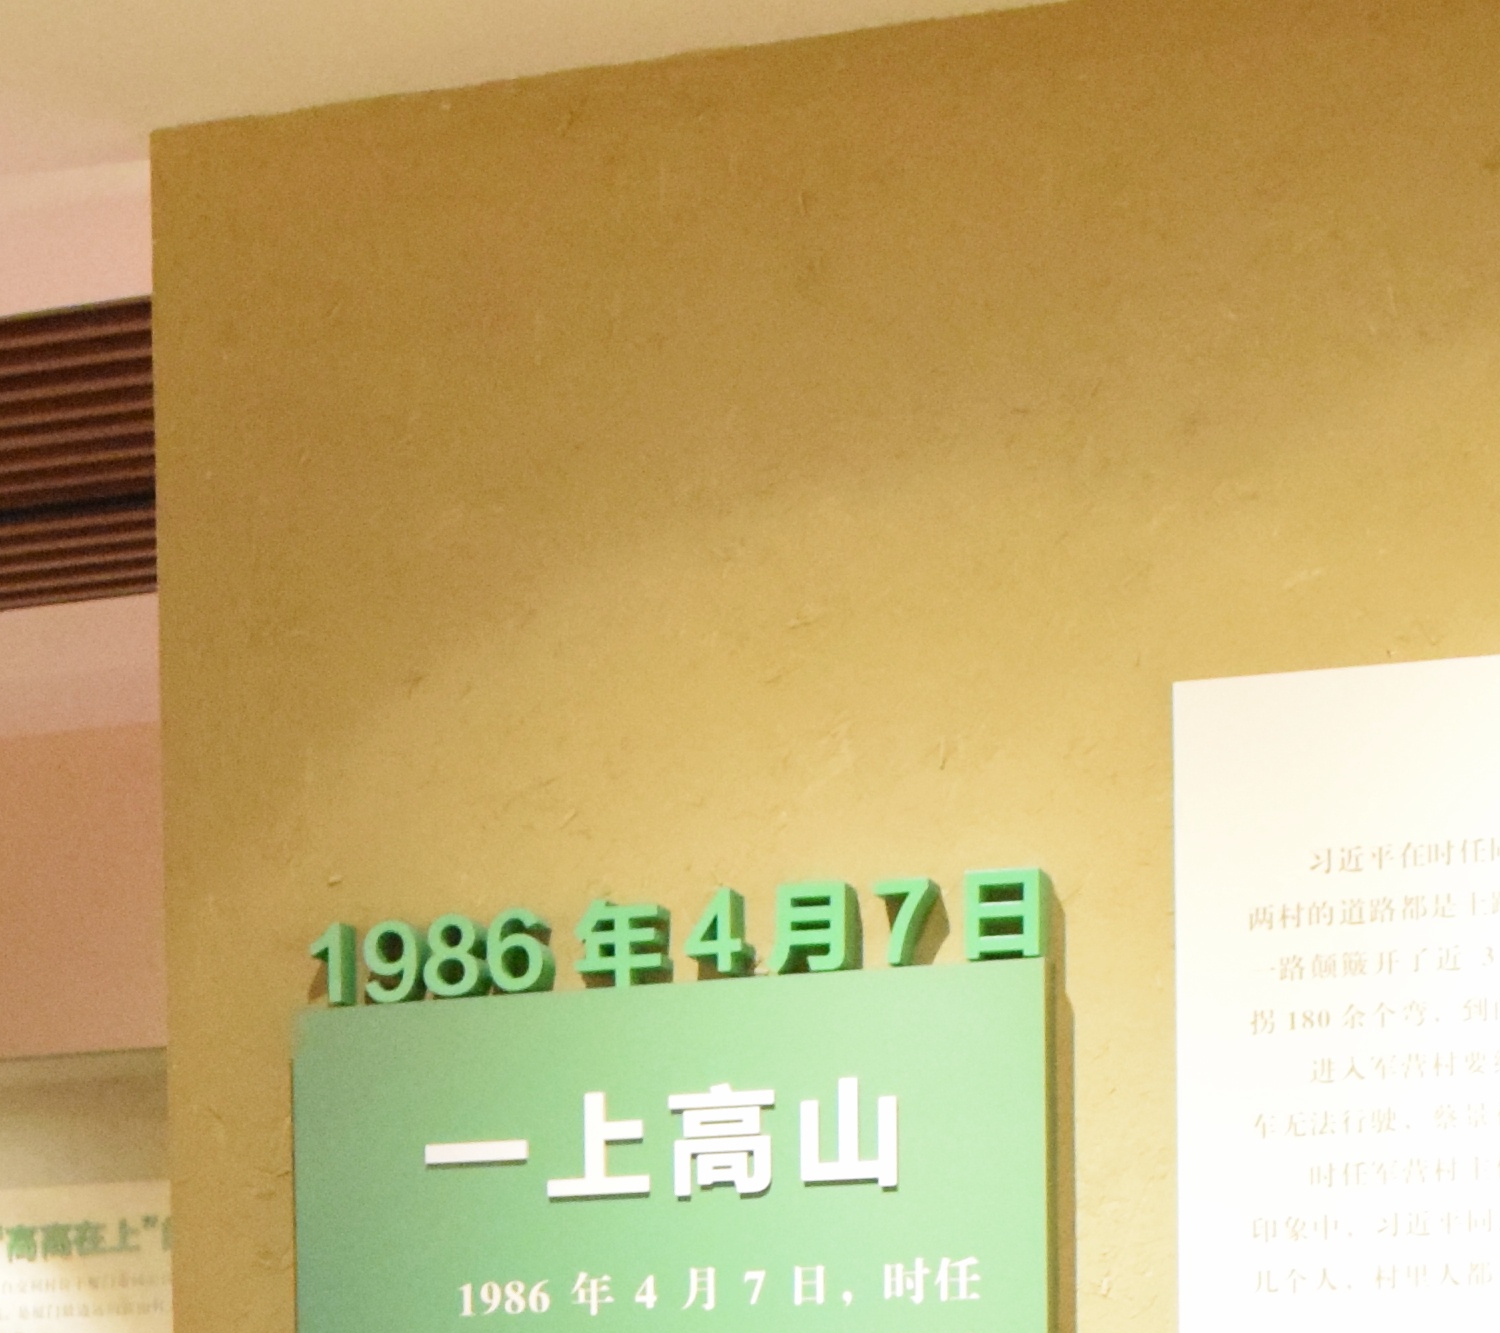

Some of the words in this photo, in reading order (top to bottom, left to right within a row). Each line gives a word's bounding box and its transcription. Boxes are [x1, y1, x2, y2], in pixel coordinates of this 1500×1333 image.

[309, 868, 1050, 1008] 1986年4月7日
[423, 1076, 900, 1201] 一上高山
